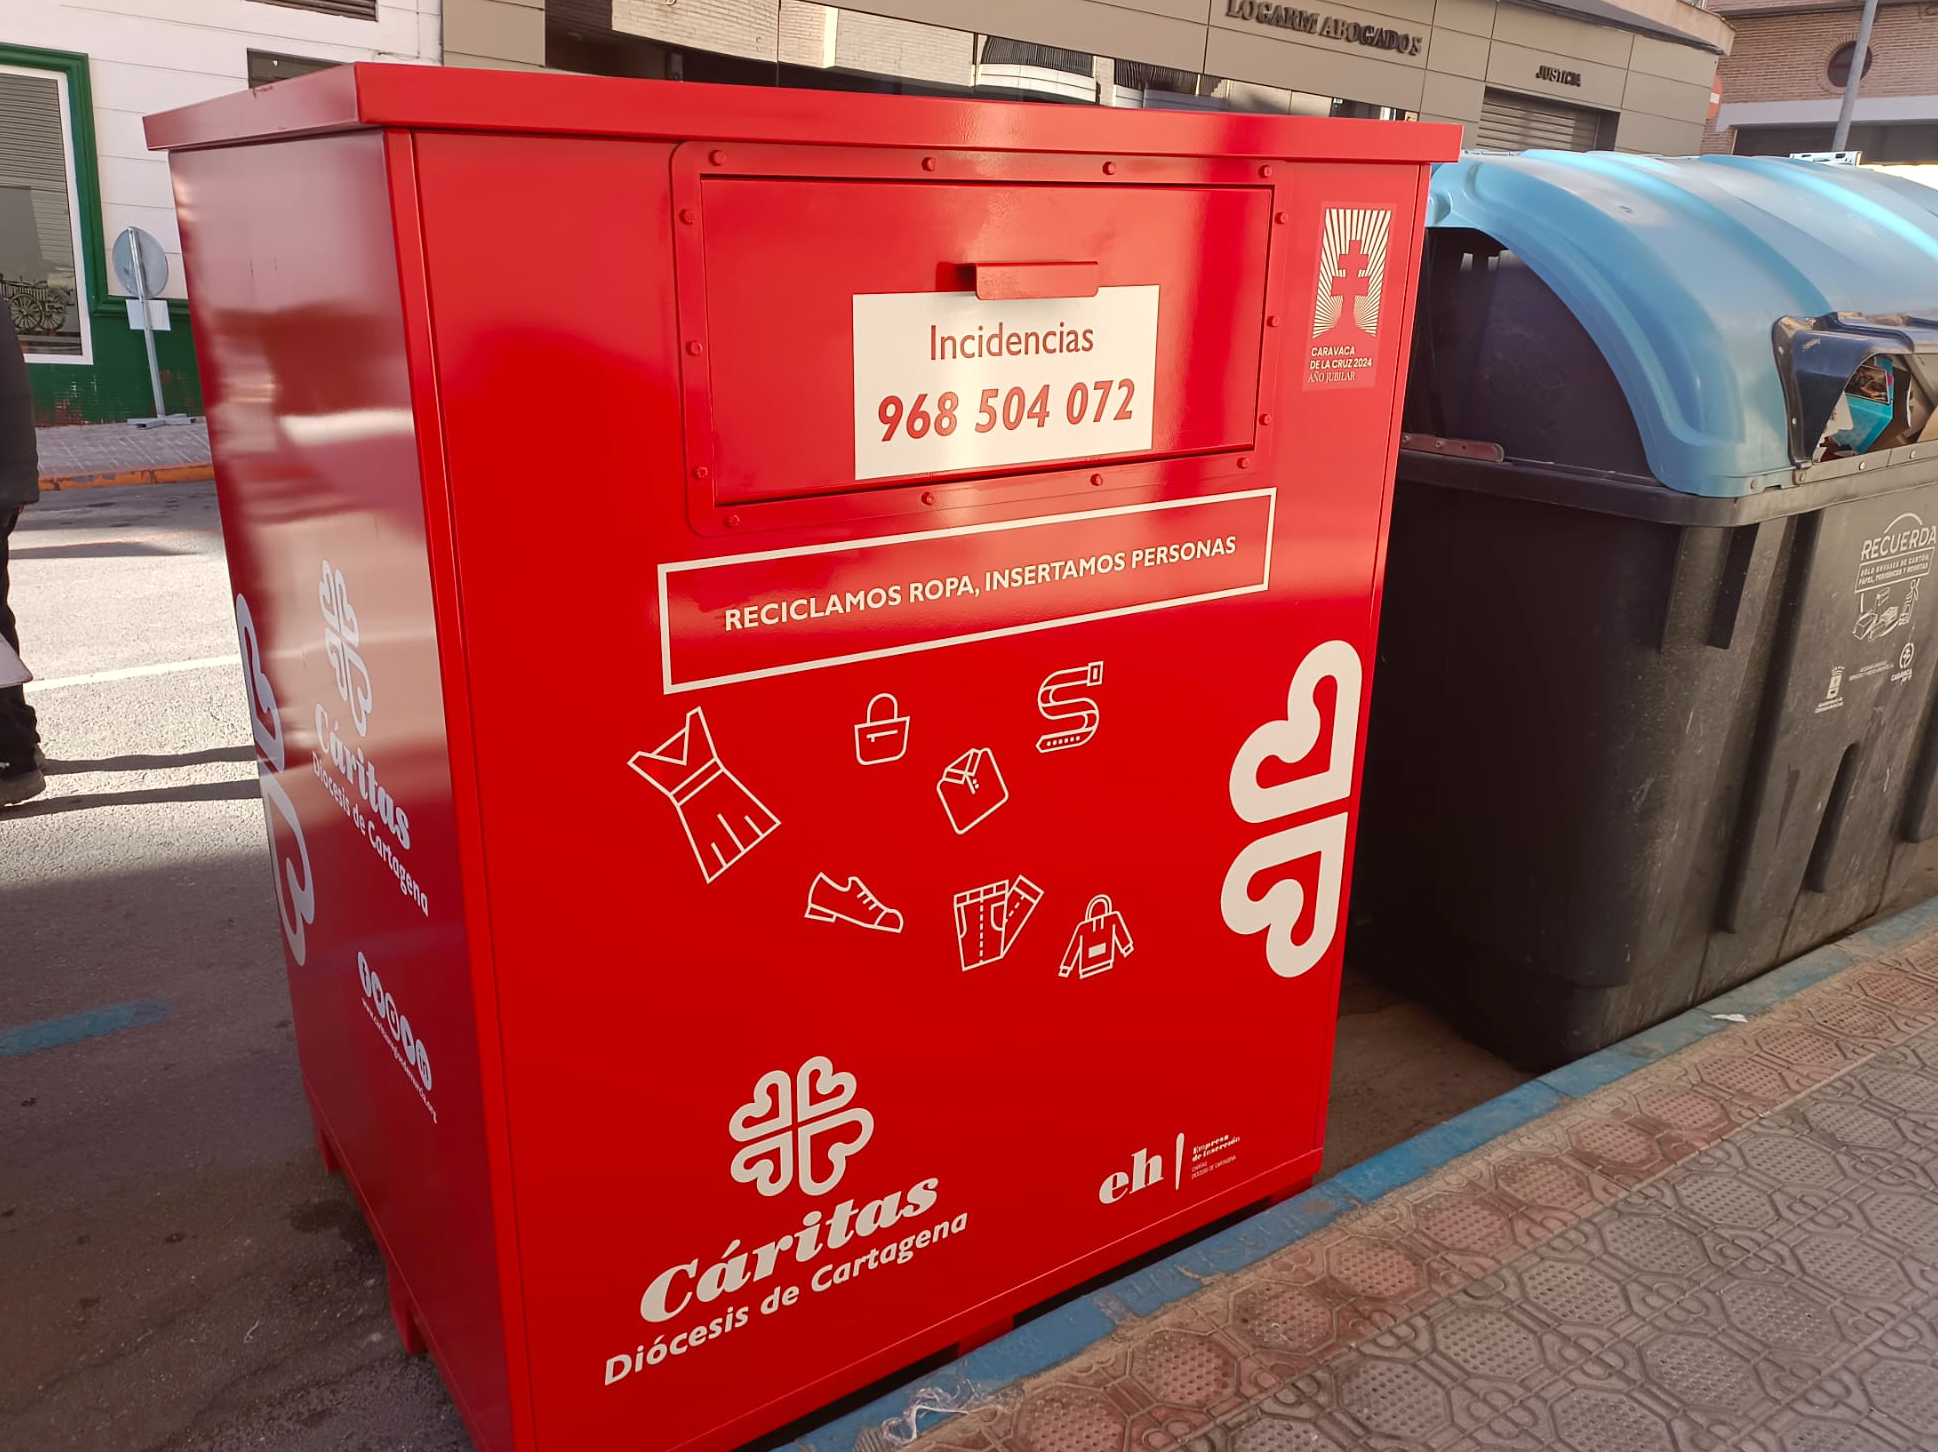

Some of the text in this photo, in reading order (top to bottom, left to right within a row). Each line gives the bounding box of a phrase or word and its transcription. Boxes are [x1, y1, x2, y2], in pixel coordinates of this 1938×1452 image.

[1319, 16, 1422, 56] ABOGADOS
[929, 321, 1094, 361] Incidencias
[1310, 357, 1373, 370] DE LA CRUZ 2024
[1311, 345, 1355, 357] CARAVACA
[1308, 370, 1356, 384] AÑO JUBILAR
[878, 378, 1135, 442] 968 504 072
[1861, 525, 1937, 561] RECUERDA
[725, 536, 1237, 631] RECICLAMOS ROPA, INSERTAMOS PERSONAS
[315, 703, 411, 850] Cáritas
[352, 803, 366, 836] de
[367, 820, 429, 917] Cartagena
[1098, 1147, 1165, 1205] eh
[1192, 1153, 1203, 1162] de
[639, 1177, 939, 1323] Cáritas
[605, 1212, 968, 1387] Diócesis de Cartagena
